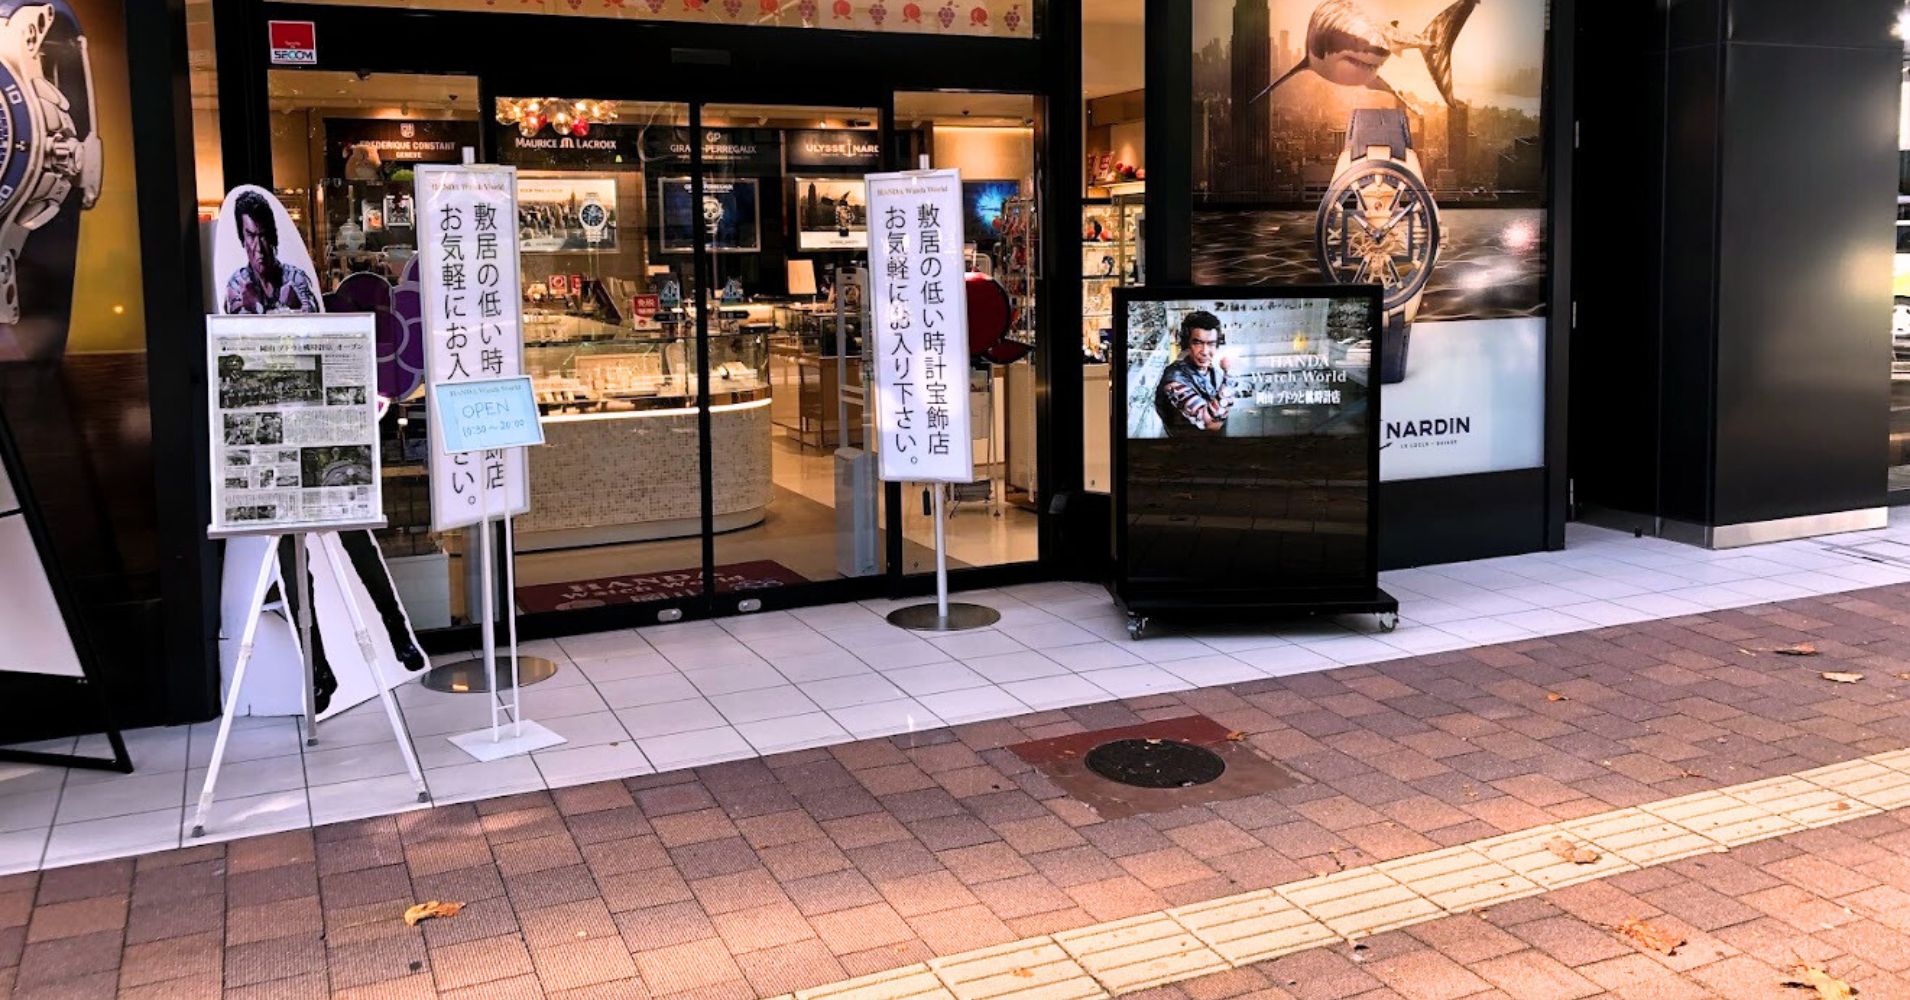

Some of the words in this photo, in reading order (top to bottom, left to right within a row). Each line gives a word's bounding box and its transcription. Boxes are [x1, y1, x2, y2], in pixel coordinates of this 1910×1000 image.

[274, 50, 313, 60] SECOM
[515, 137, 557, 149] MAURICE
[576, 139, 617, 149] LACROIX
[706, 131, 721, 143] GP
[412, 141, 456, 150] CONSTANT
[806, 144, 846, 153] ULYSSE
[885, 205, 918, 464] お気軽にお入り下さい。
[916, 203, 950, 455] 敷居の低い時計宝飾店
[1269, 354, 1329, 368] HANDA
[1250, 370, 1297, 383] Watch
[1302, 370, 1347, 383] World
[462, 399, 510, 419] OPEN
[1386, 416, 1470, 439] NARDIN
